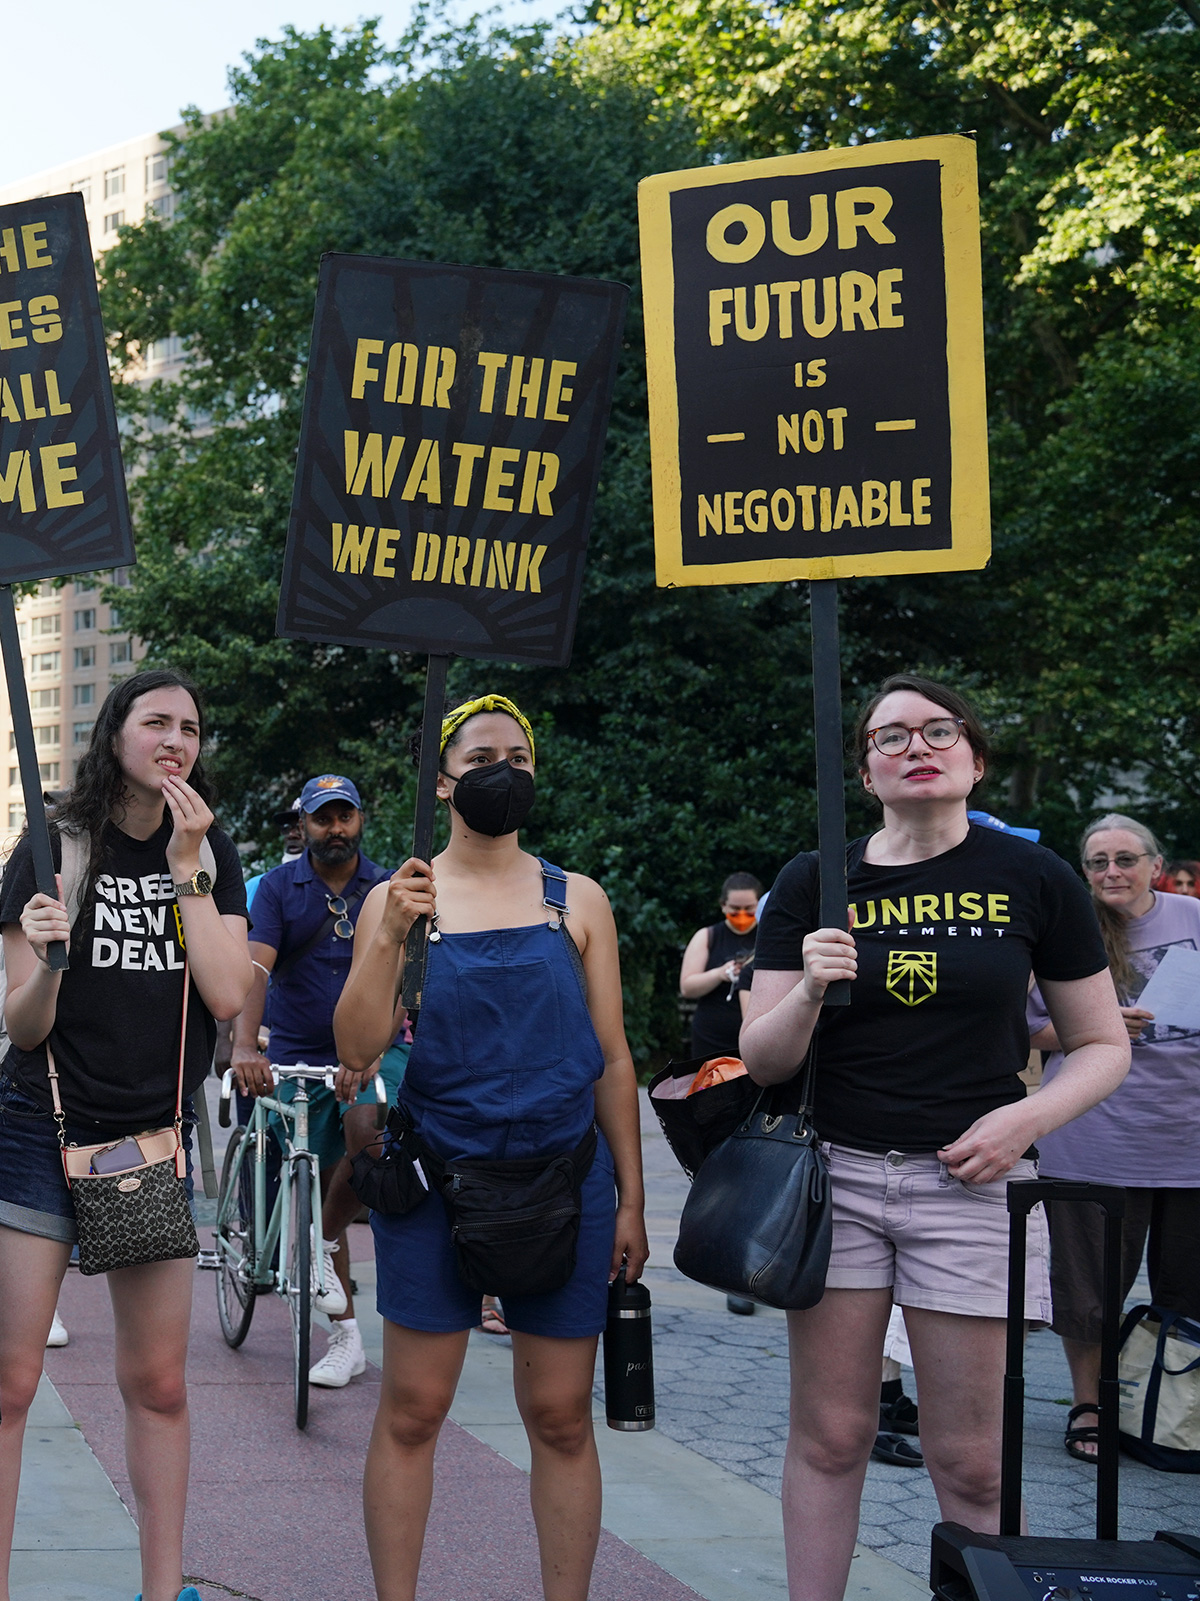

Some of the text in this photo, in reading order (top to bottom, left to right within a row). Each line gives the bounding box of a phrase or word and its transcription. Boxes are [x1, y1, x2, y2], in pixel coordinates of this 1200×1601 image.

[707, 187, 896, 263] OUR
[709, 268, 904, 346] FUTURE
[351, 339, 577, 422] FOR THE
[795, 359, 826, 387] IS
[778, 408, 847, 454] NOT
[345, 430, 559, 516] WATER
[698, 478, 931, 536] NEGOTIABLE
[332, 523, 547, 593] WE DRINK
[95, 873, 176, 904] GREE
[848, 892, 1011, 929] UNRISE
[93, 902, 166, 936] NEW
[92, 937, 184, 971] DEAL
[1080, 1575, 1106, 1583] BLOCK
[1106, 1577, 1137, 1585] ROCKER
